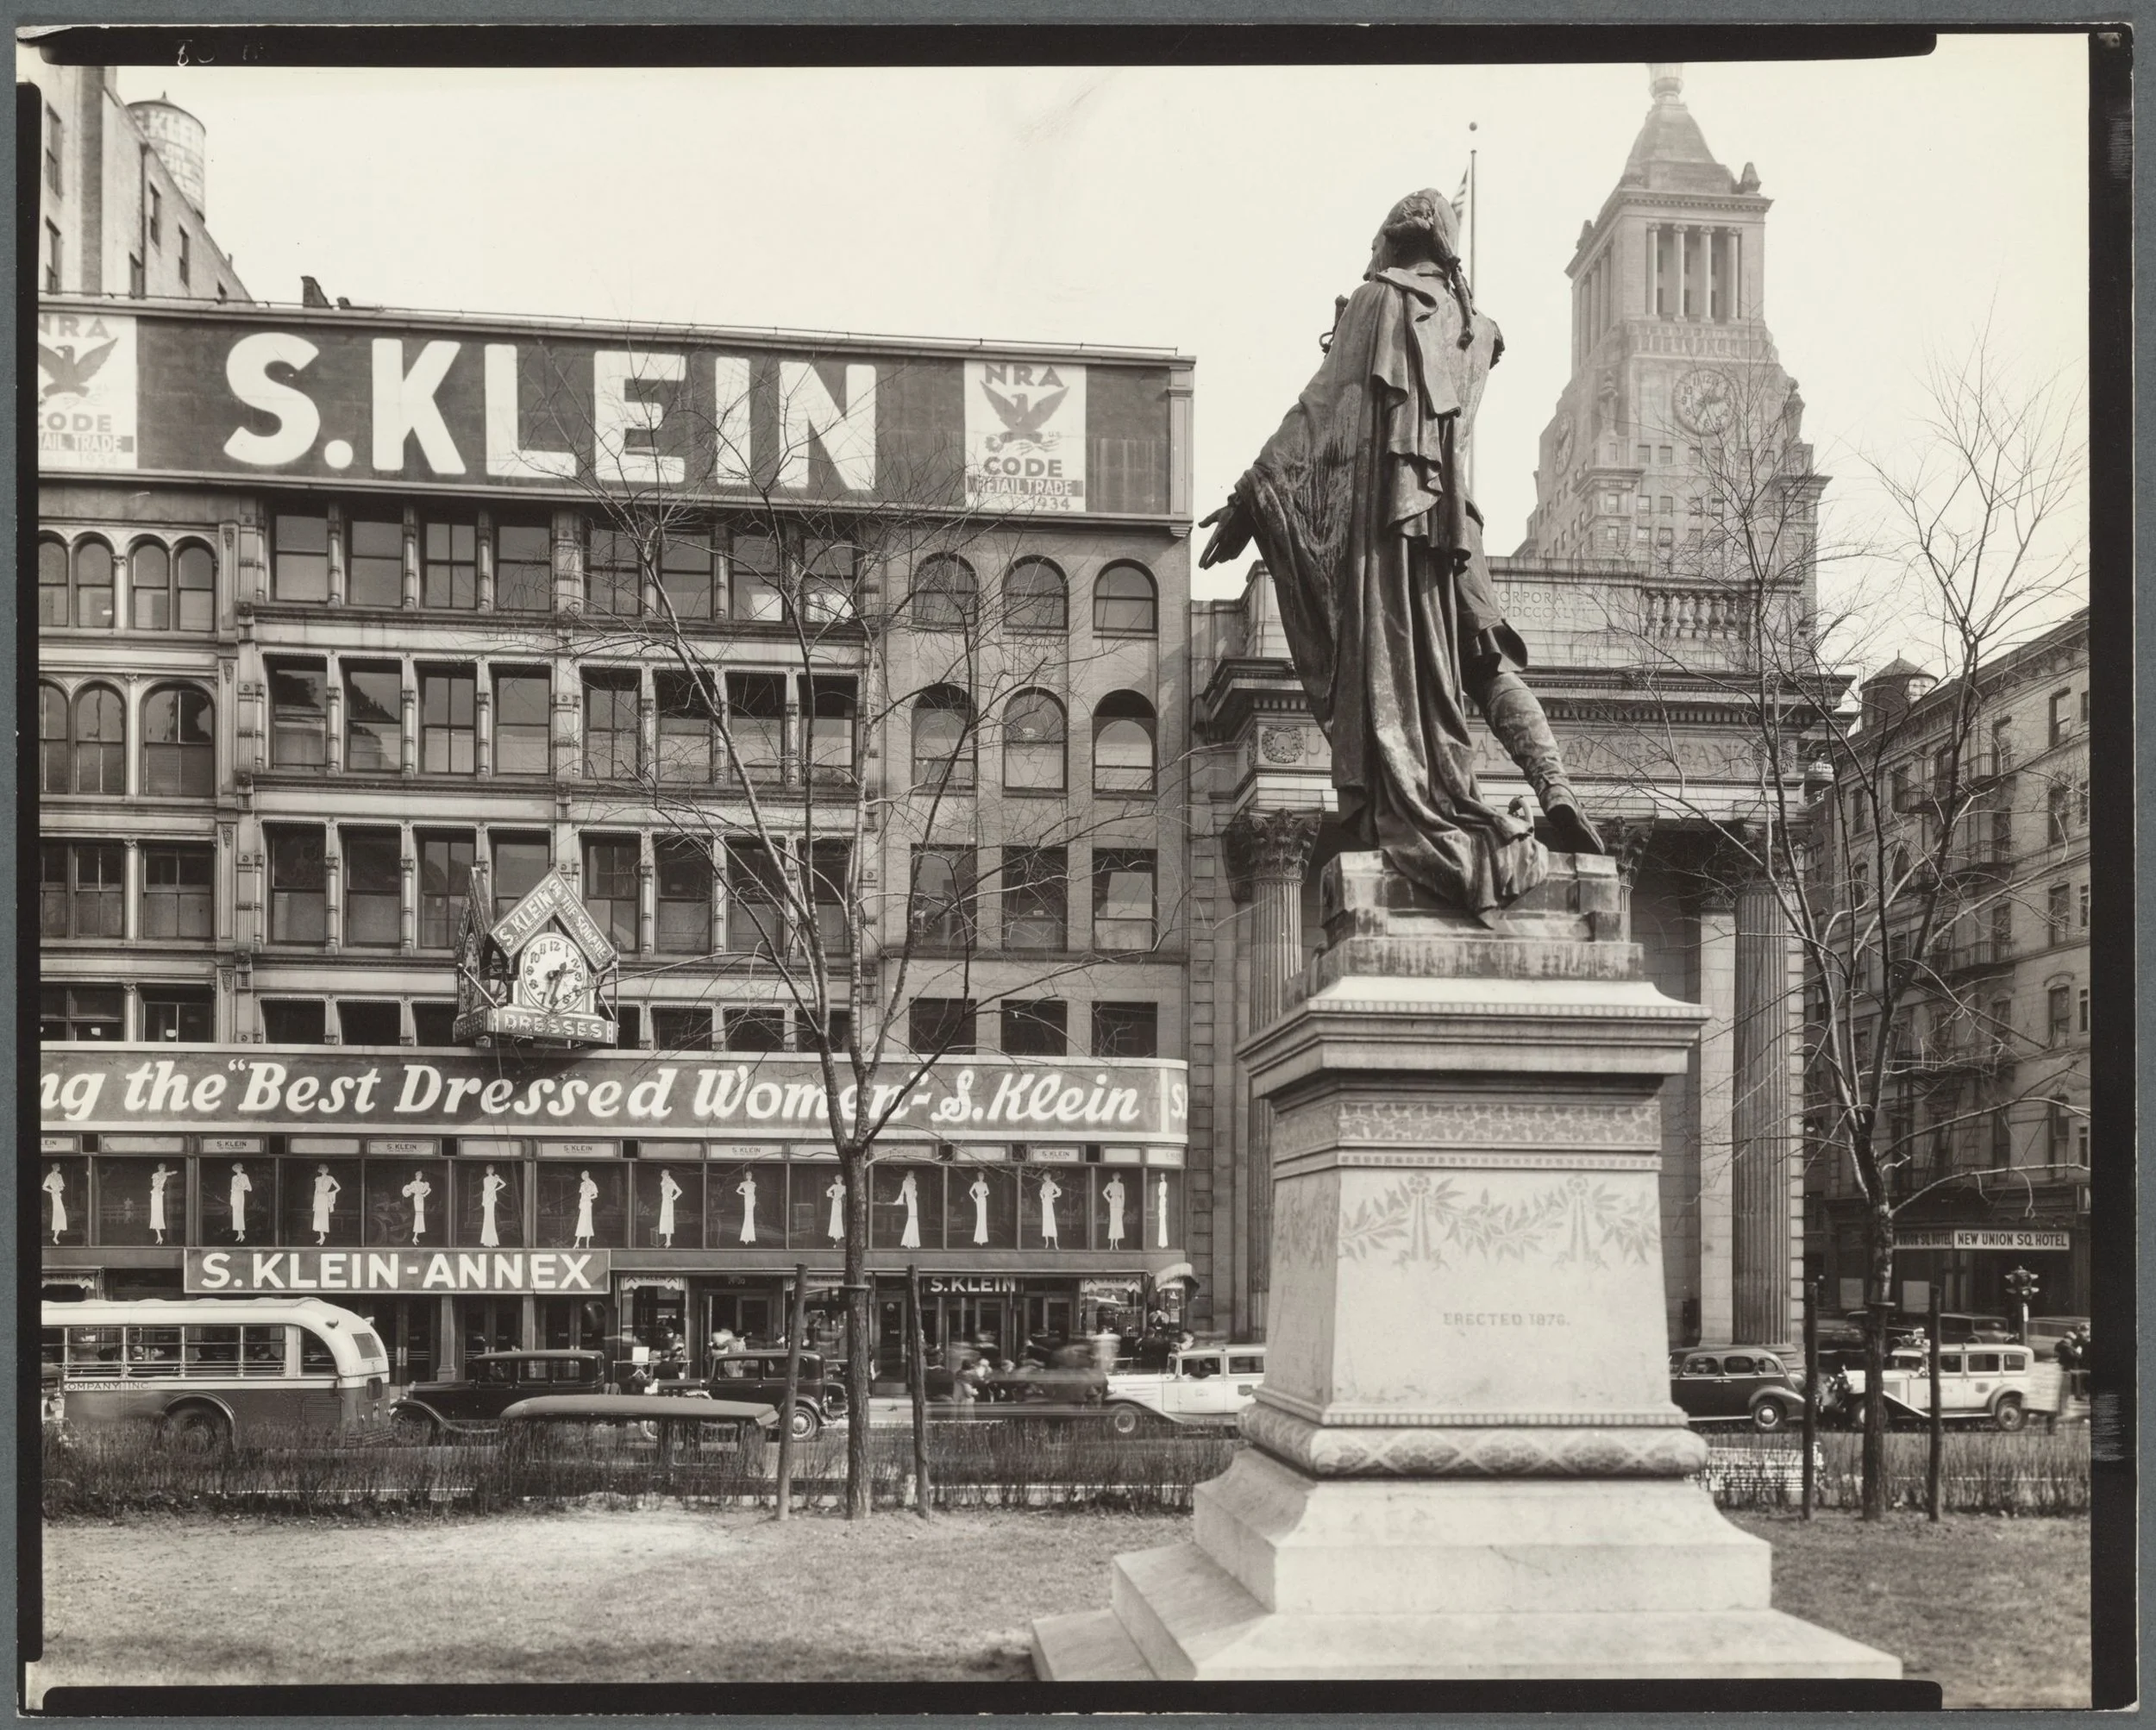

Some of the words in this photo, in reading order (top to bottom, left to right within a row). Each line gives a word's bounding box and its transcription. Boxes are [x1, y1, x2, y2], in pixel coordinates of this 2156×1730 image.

[985, 363, 1064, 388] NRA
[74, 435, 122, 452] TRADE
[983, 456, 1063, 478] CODE
[1026, 479, 1073, 496] TRADE
[1033, 497, 1070, 511] 934
[510, 888, 555, 931] KLEIN
[505, 1013, 603, 1038] DRESSES
[123, 1060, 227, 1112] the
[393, 1063, 679, 1119] Dressed
[1958, 1232, 1978, 1245] NEW
[1982, 1232, 2014, 1245] UNION
[2035, 1233, 2067, 1247] HOTEL
[1443, 1313, 1523, 1326] ERECTED
